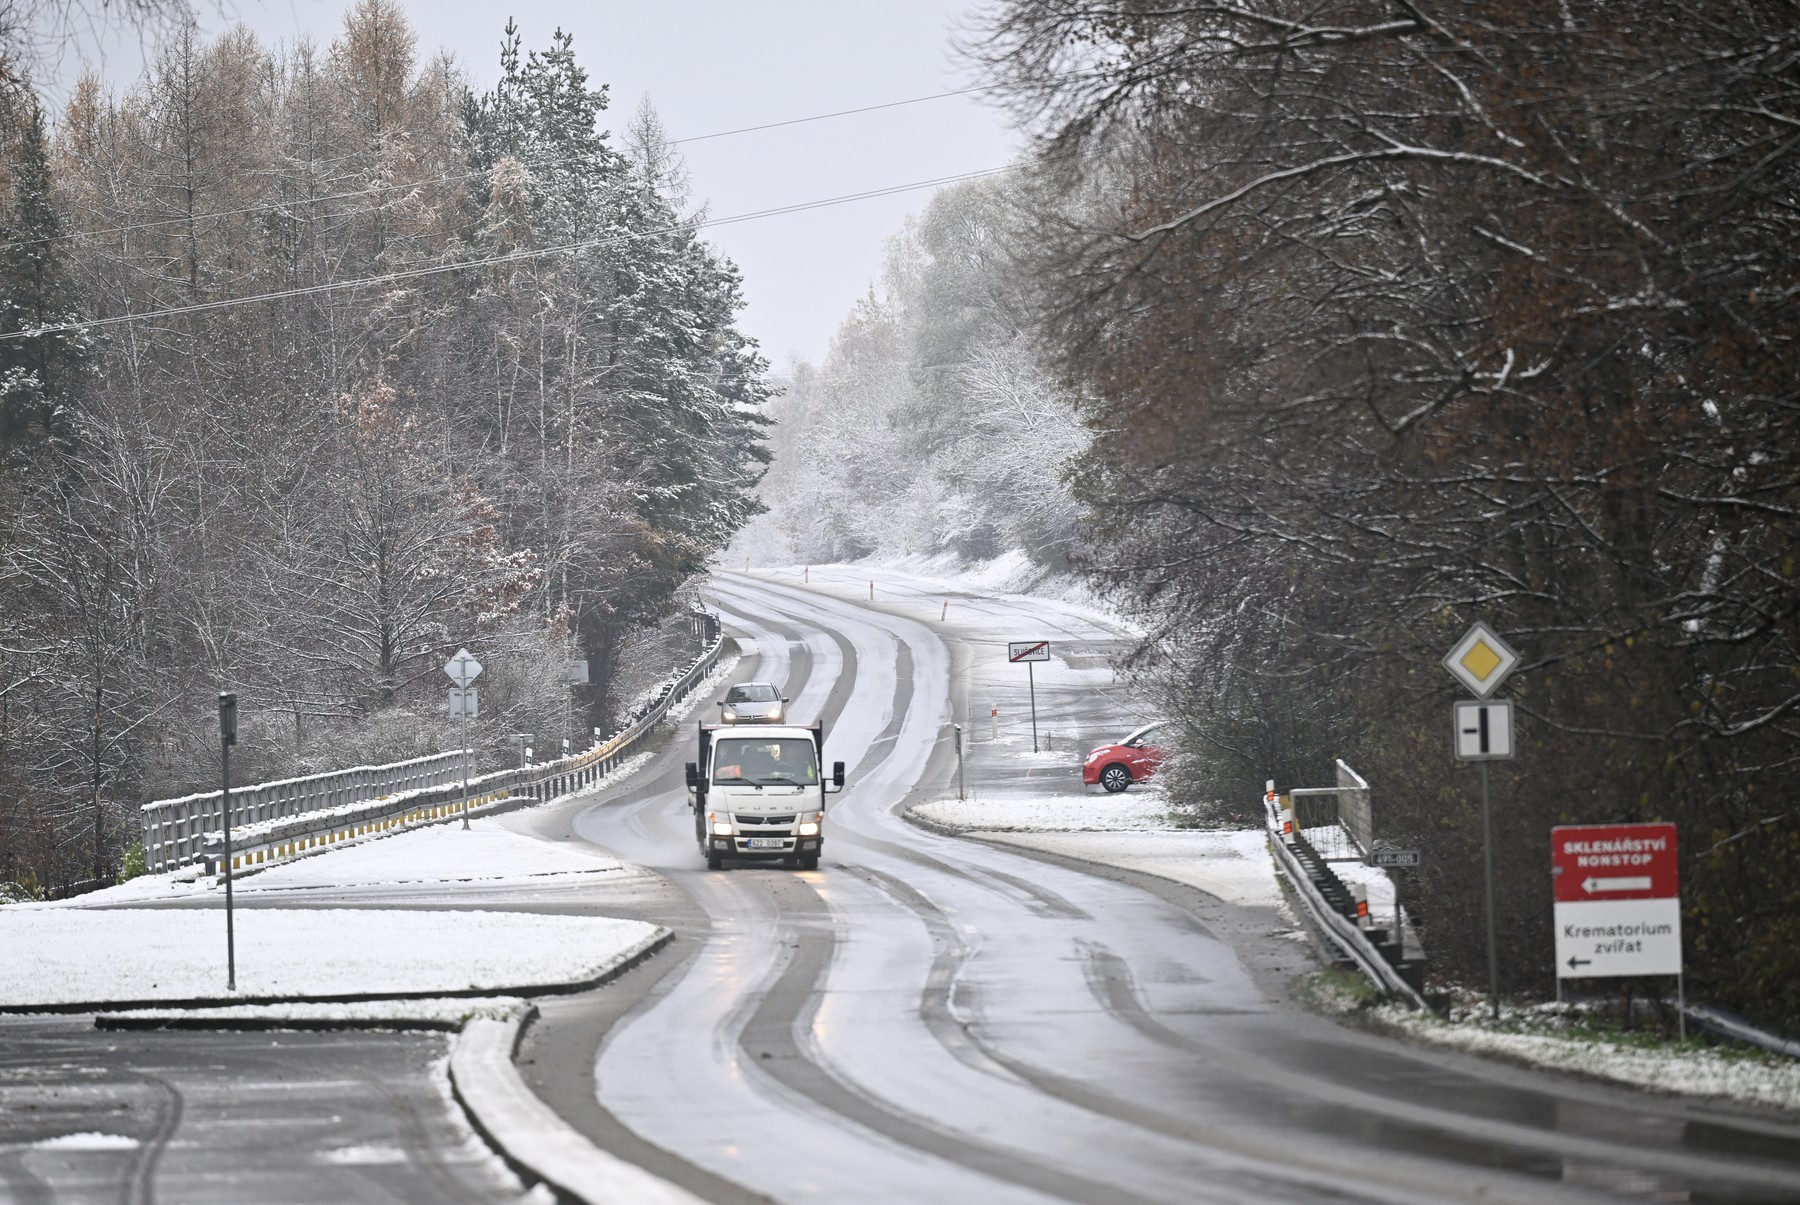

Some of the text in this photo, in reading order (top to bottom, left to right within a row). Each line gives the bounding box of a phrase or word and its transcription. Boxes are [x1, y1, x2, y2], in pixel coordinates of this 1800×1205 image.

[1563, 836, 1666, 854] SKLENÁŘSTVÍ
[1577, 854, 1653, 867] NONSTOP
[1564, 922, 1672, 938] Krematorium
[1594, 940, 1643, 954] zvířat
